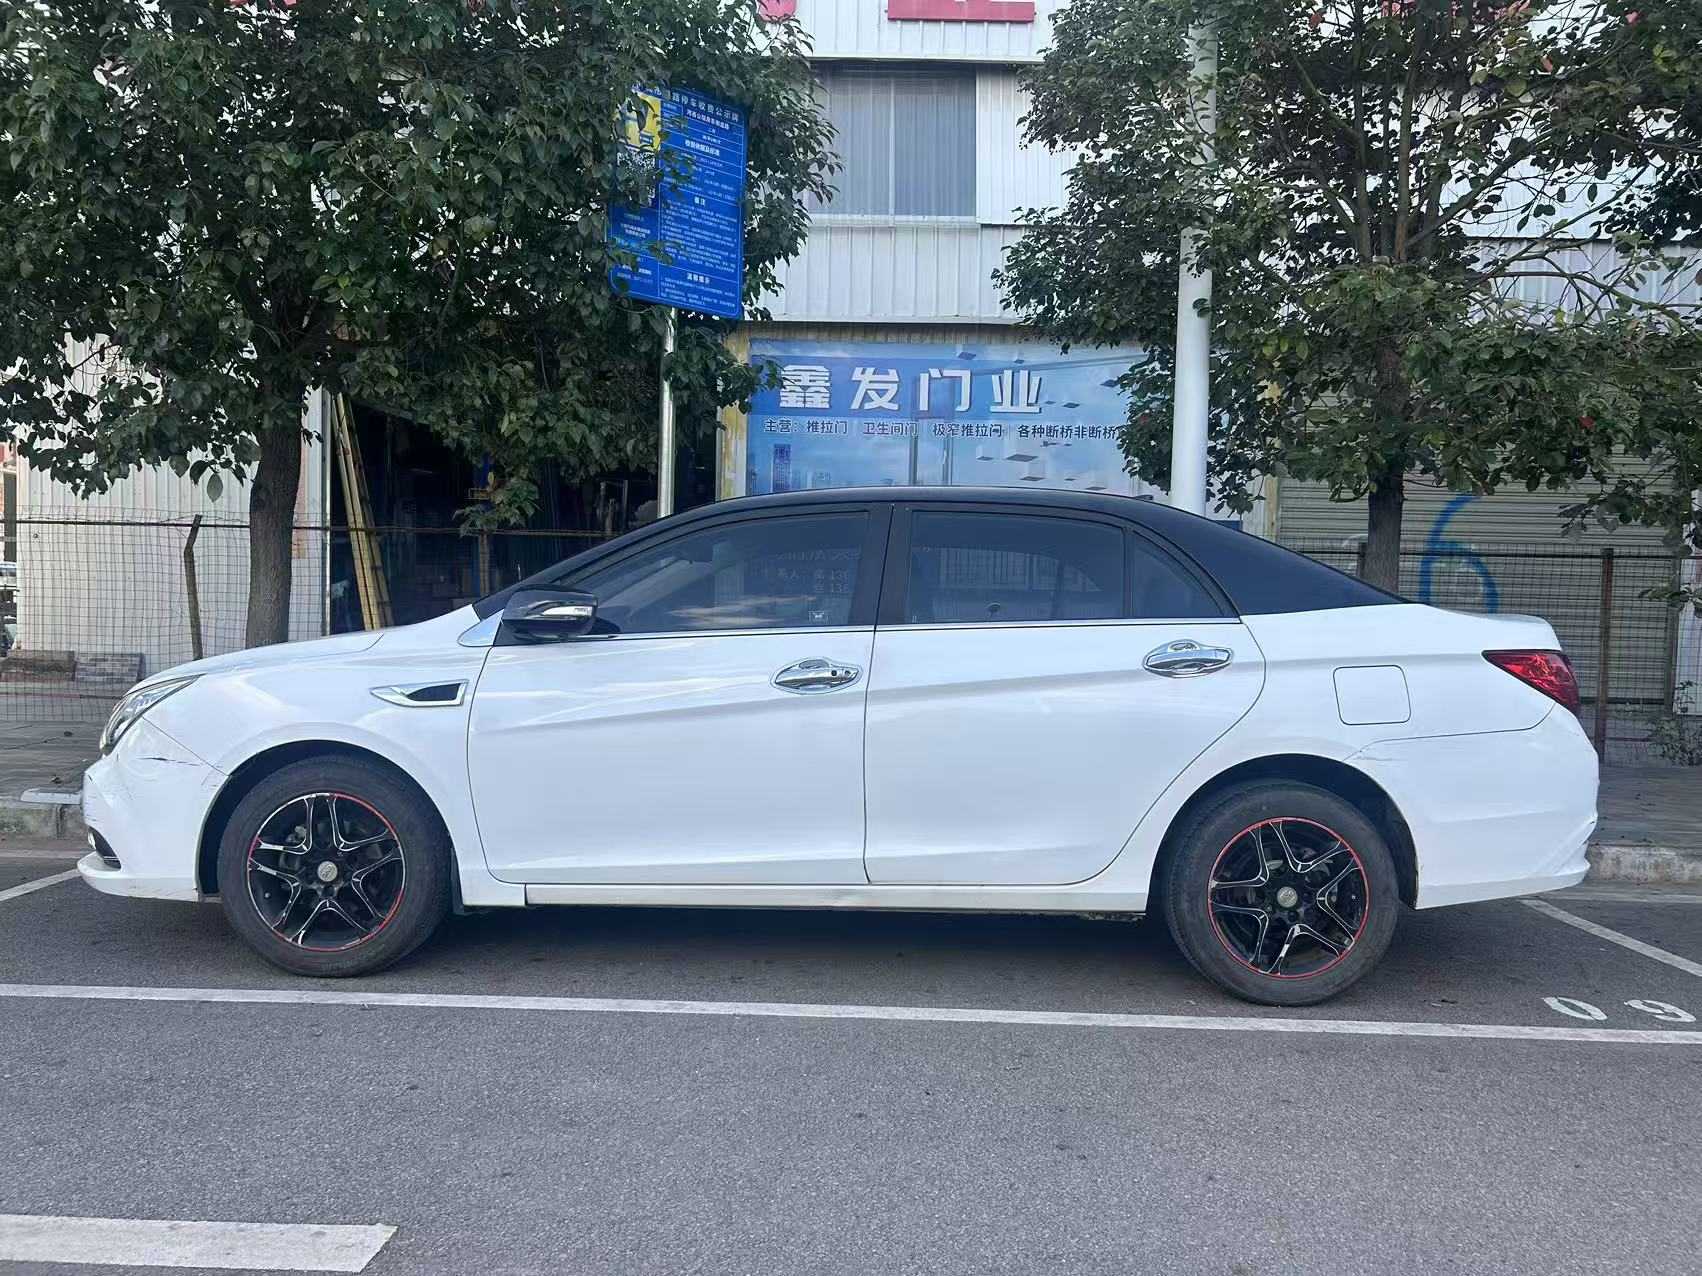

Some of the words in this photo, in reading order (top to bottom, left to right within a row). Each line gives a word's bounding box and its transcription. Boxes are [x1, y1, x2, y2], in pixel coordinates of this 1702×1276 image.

[662, 88, 739, 122] 路停车收费公示牌
[779, 364, 1042, 414] 鑫发门业
[863, 421, 918, 436] 卫生间门
